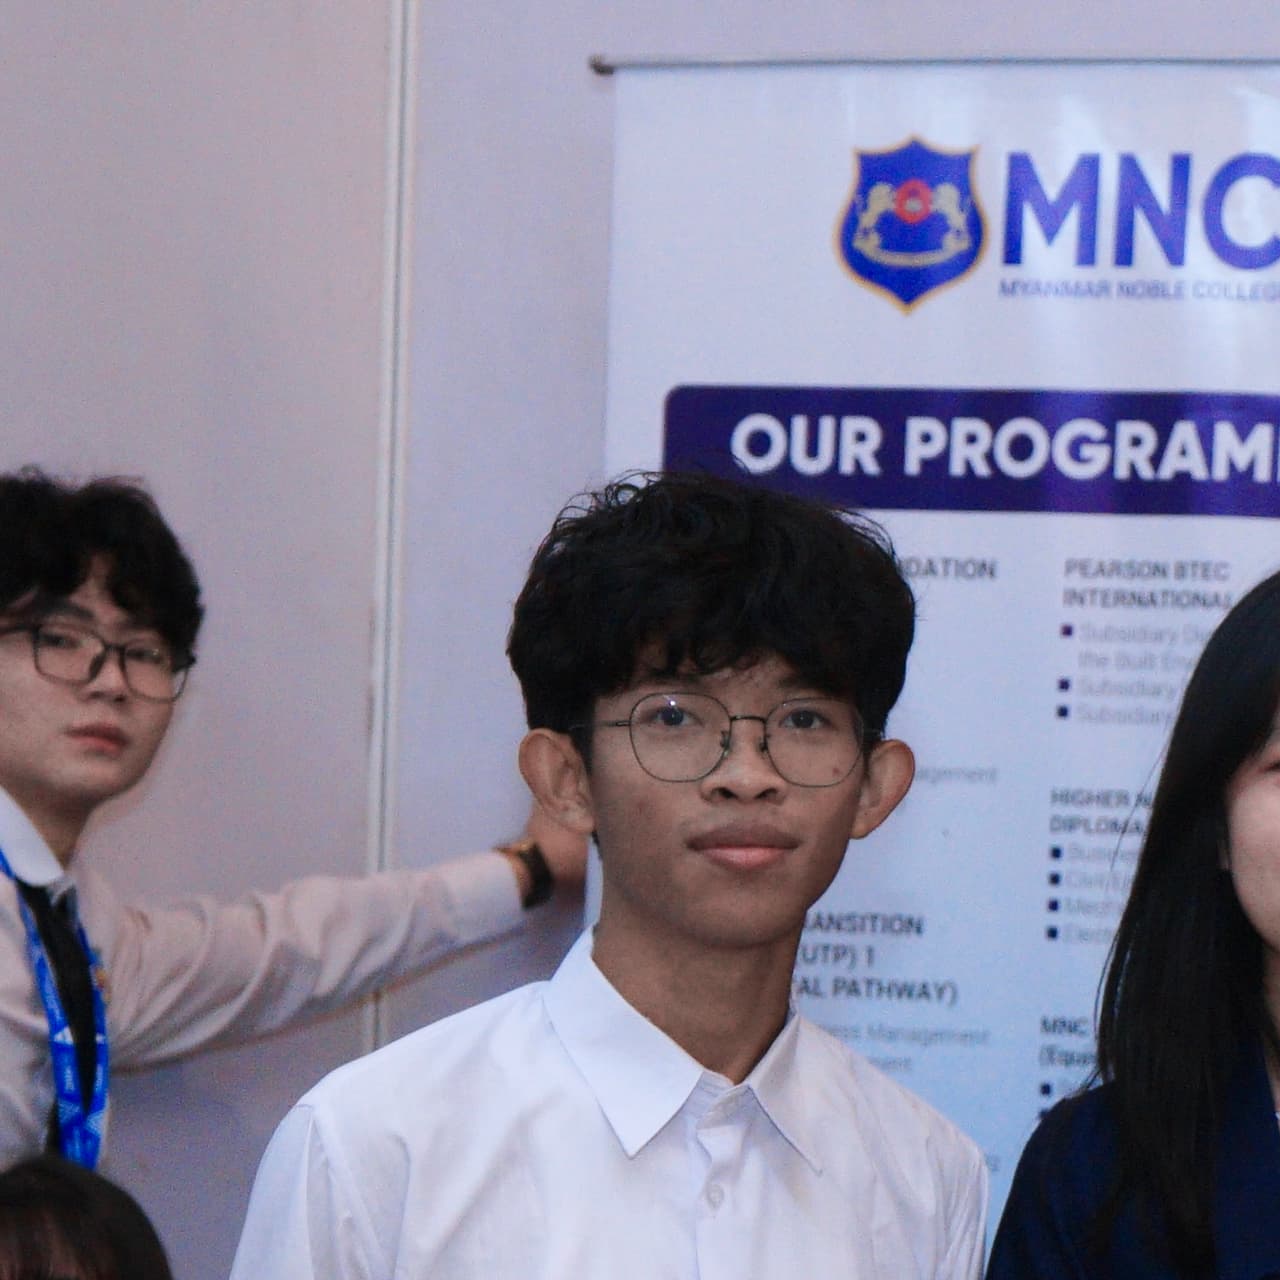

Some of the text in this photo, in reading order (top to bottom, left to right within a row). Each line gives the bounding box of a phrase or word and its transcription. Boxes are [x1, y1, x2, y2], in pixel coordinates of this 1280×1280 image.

[999, 279, 1111, 301] MYANMAR
[1116, 280, 1186, 301] NOBLE
[730, 413, 883, 477] OUR
[1063, 557, 1168, 580] PEARSON
[808, 912, 925, 936] ANSITION
